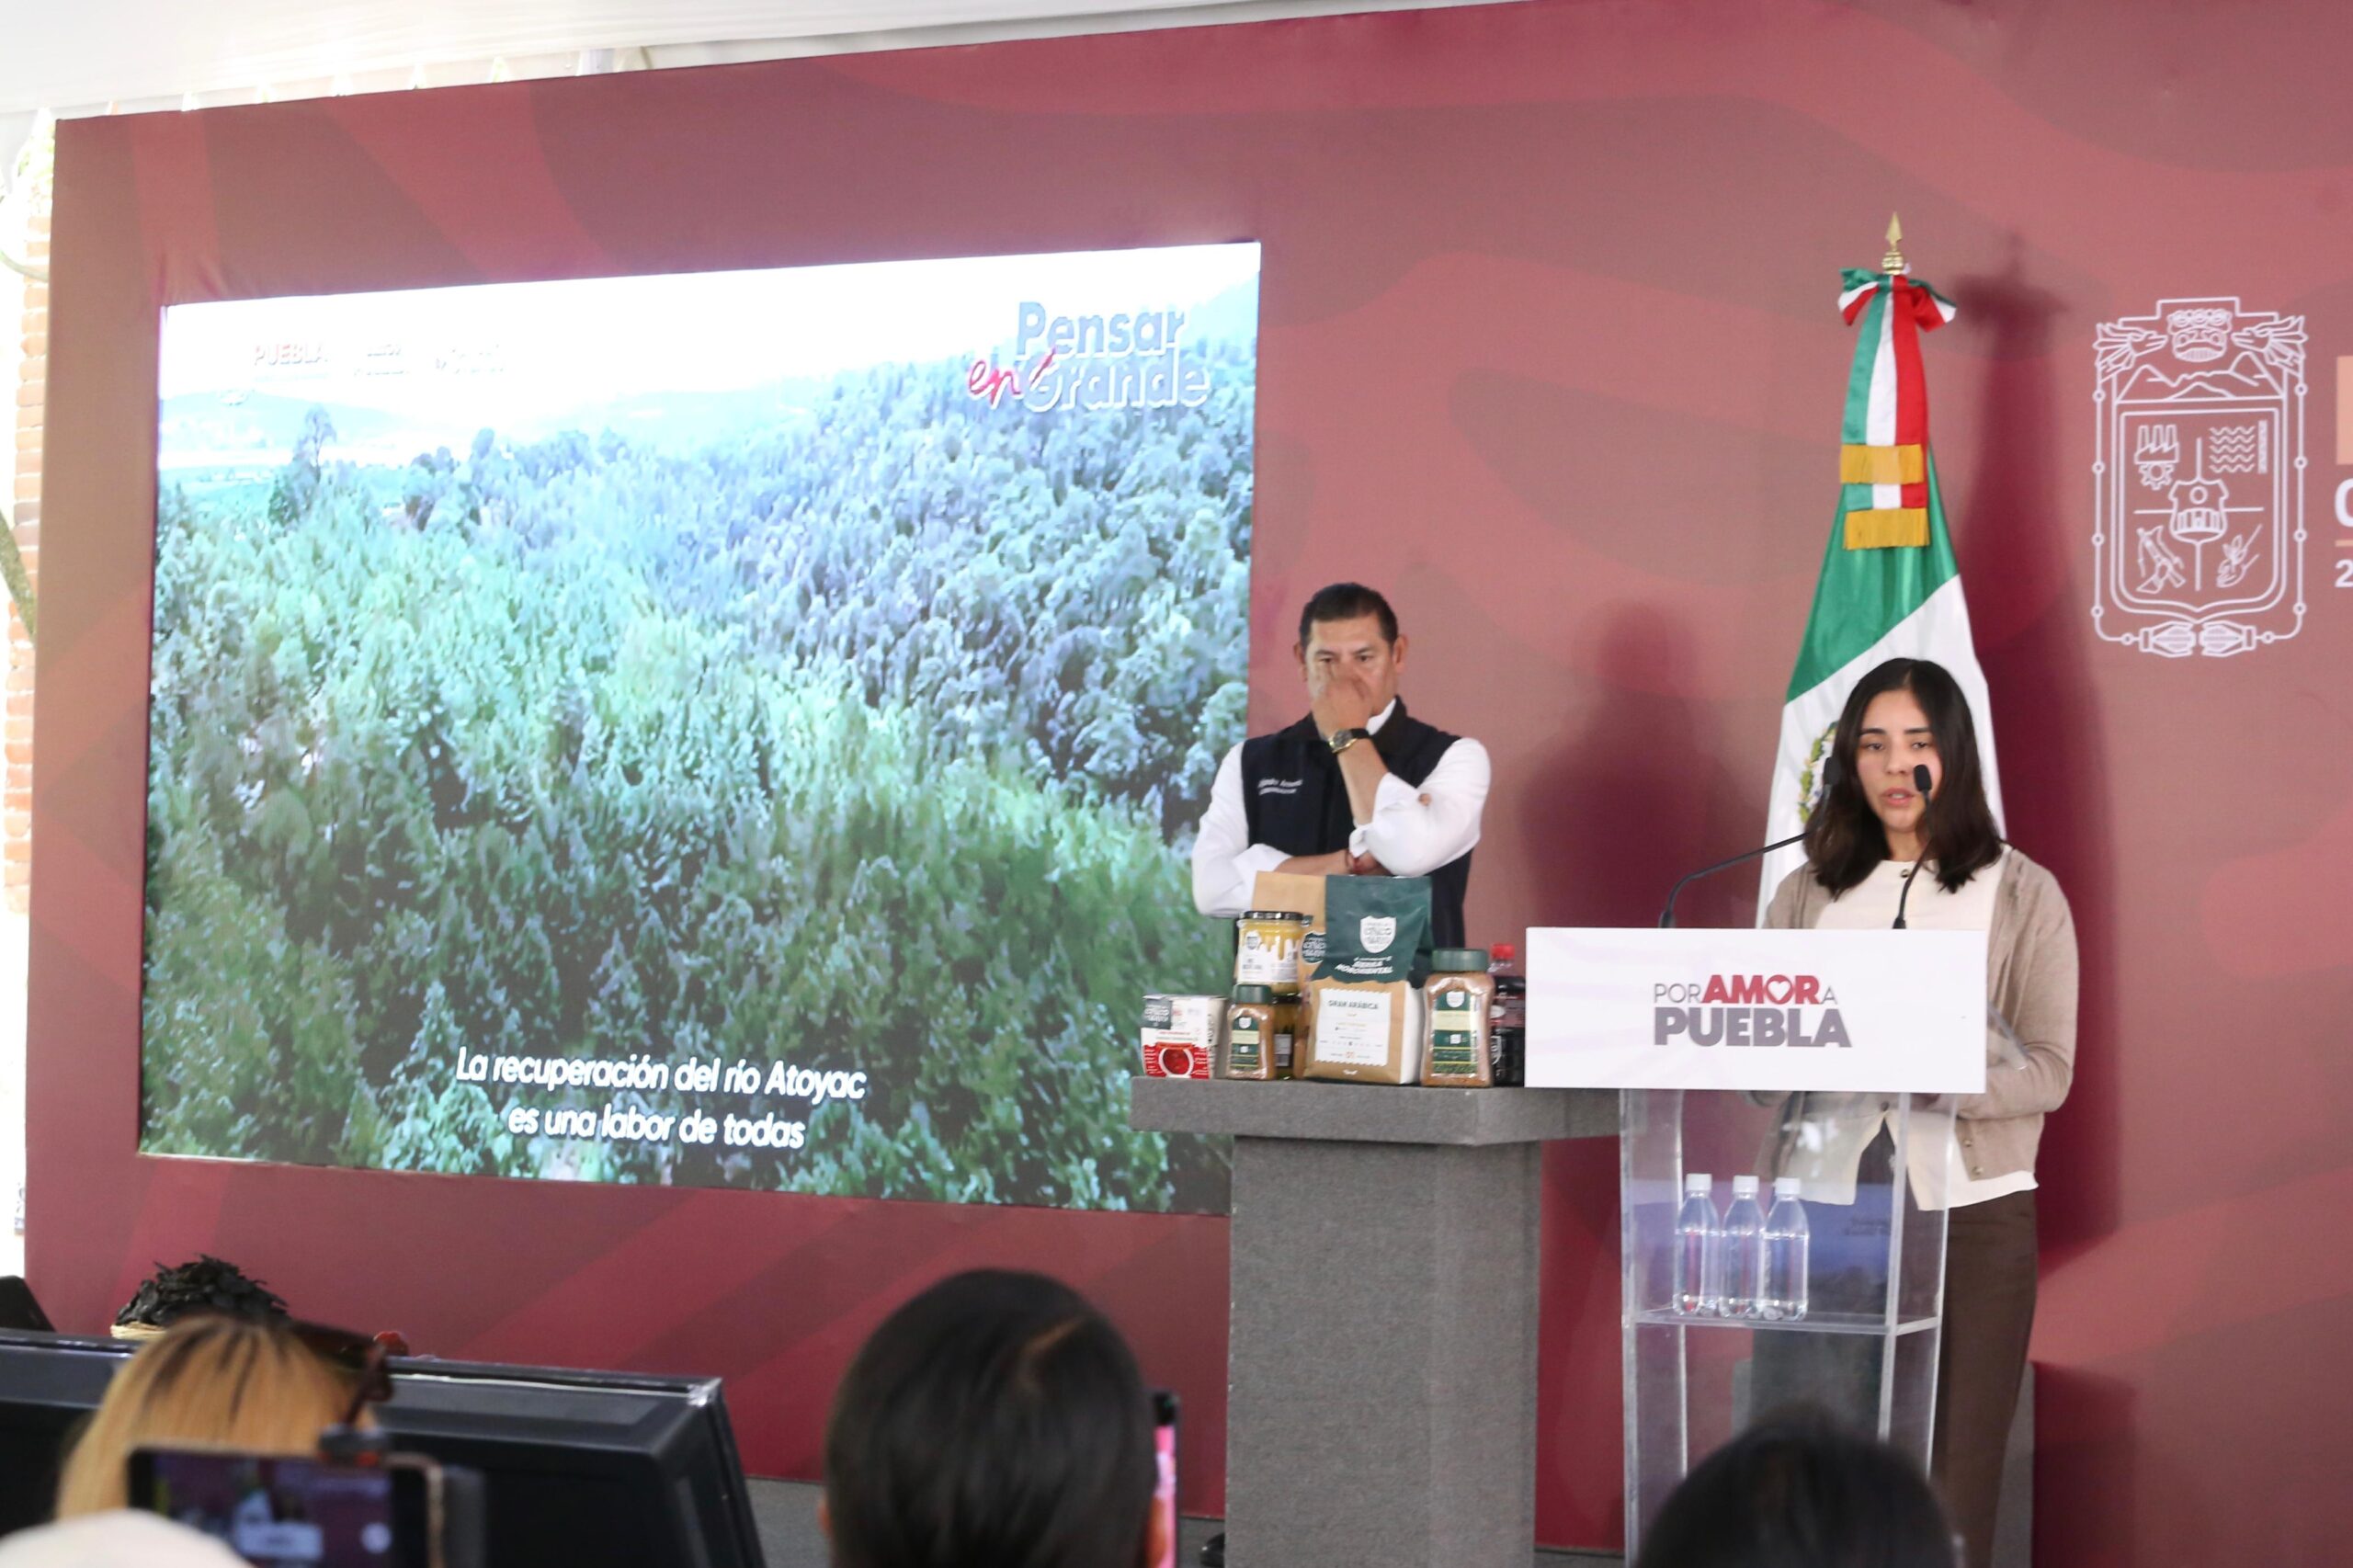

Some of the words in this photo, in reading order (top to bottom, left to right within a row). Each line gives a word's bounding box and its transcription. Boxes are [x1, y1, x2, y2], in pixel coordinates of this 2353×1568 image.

[1016, 301, 1187, 359] Pensar
[968, 359, 1023, 409] en
[1021, 347, 1211, 413] Grande
[1654, 983, 1701, 1004] POR
[1700, 974, 1821, 1005] AMOR
[1820, 985, 1838, 1005] A
[1654, 1007, 1853, 1048] PUEBLA
[456, 1047, 488, 1081] La
[492, 1054, 670, 1092] recuperación
[674, 1056, 722, 1092] del
[723, 1059, 761, 1095] río
[764, 1060, 868, 1106] Atoyac
[507, 1107, 540, 1135] es
[544, 1108, 597, 1138] una
[601, 1103, 676, 1142] labor
[678, 1108, 718, 1144] de
[723, 1111, 806, 1150] todas
